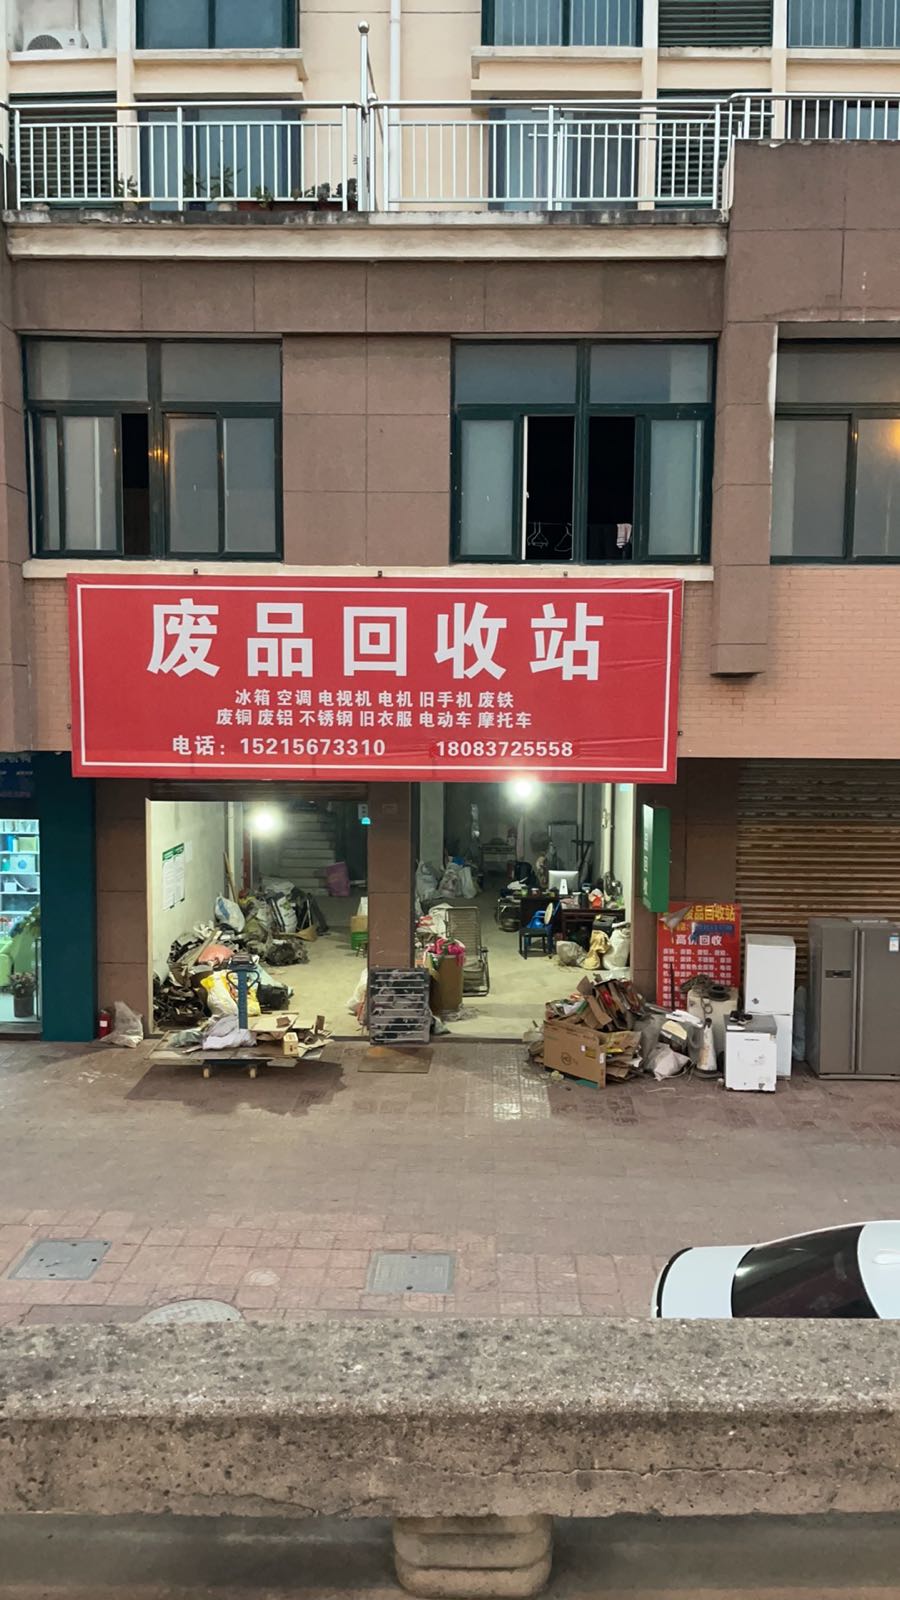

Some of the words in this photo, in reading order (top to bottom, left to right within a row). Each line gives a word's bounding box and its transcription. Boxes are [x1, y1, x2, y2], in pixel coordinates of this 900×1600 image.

[146, 597, 605, 682] 废品回收站
[234, 688, 271, 706] 冰箱
[276, 689, 312, 706] 空调
[318, 689, 373, 707] 电视机
[378, 690, 414, 708] 电机
[419, 690, 474, 709] 旧手机
[477, 690, 515, 709] 废铁
[215, 708, 252, 726] 废铜
[257, 708, 294, 727] 废铝
[299, 709, 354, 728] 不锈钢
[359, 710, 414, 728] 旧衣服
[419, 710, 473, 729] 电动车
[477, 711, 533, 729] 摩托车
[240, 737, 386, 757] 15215673310
[436, 740, 574, 758] 18083725558
